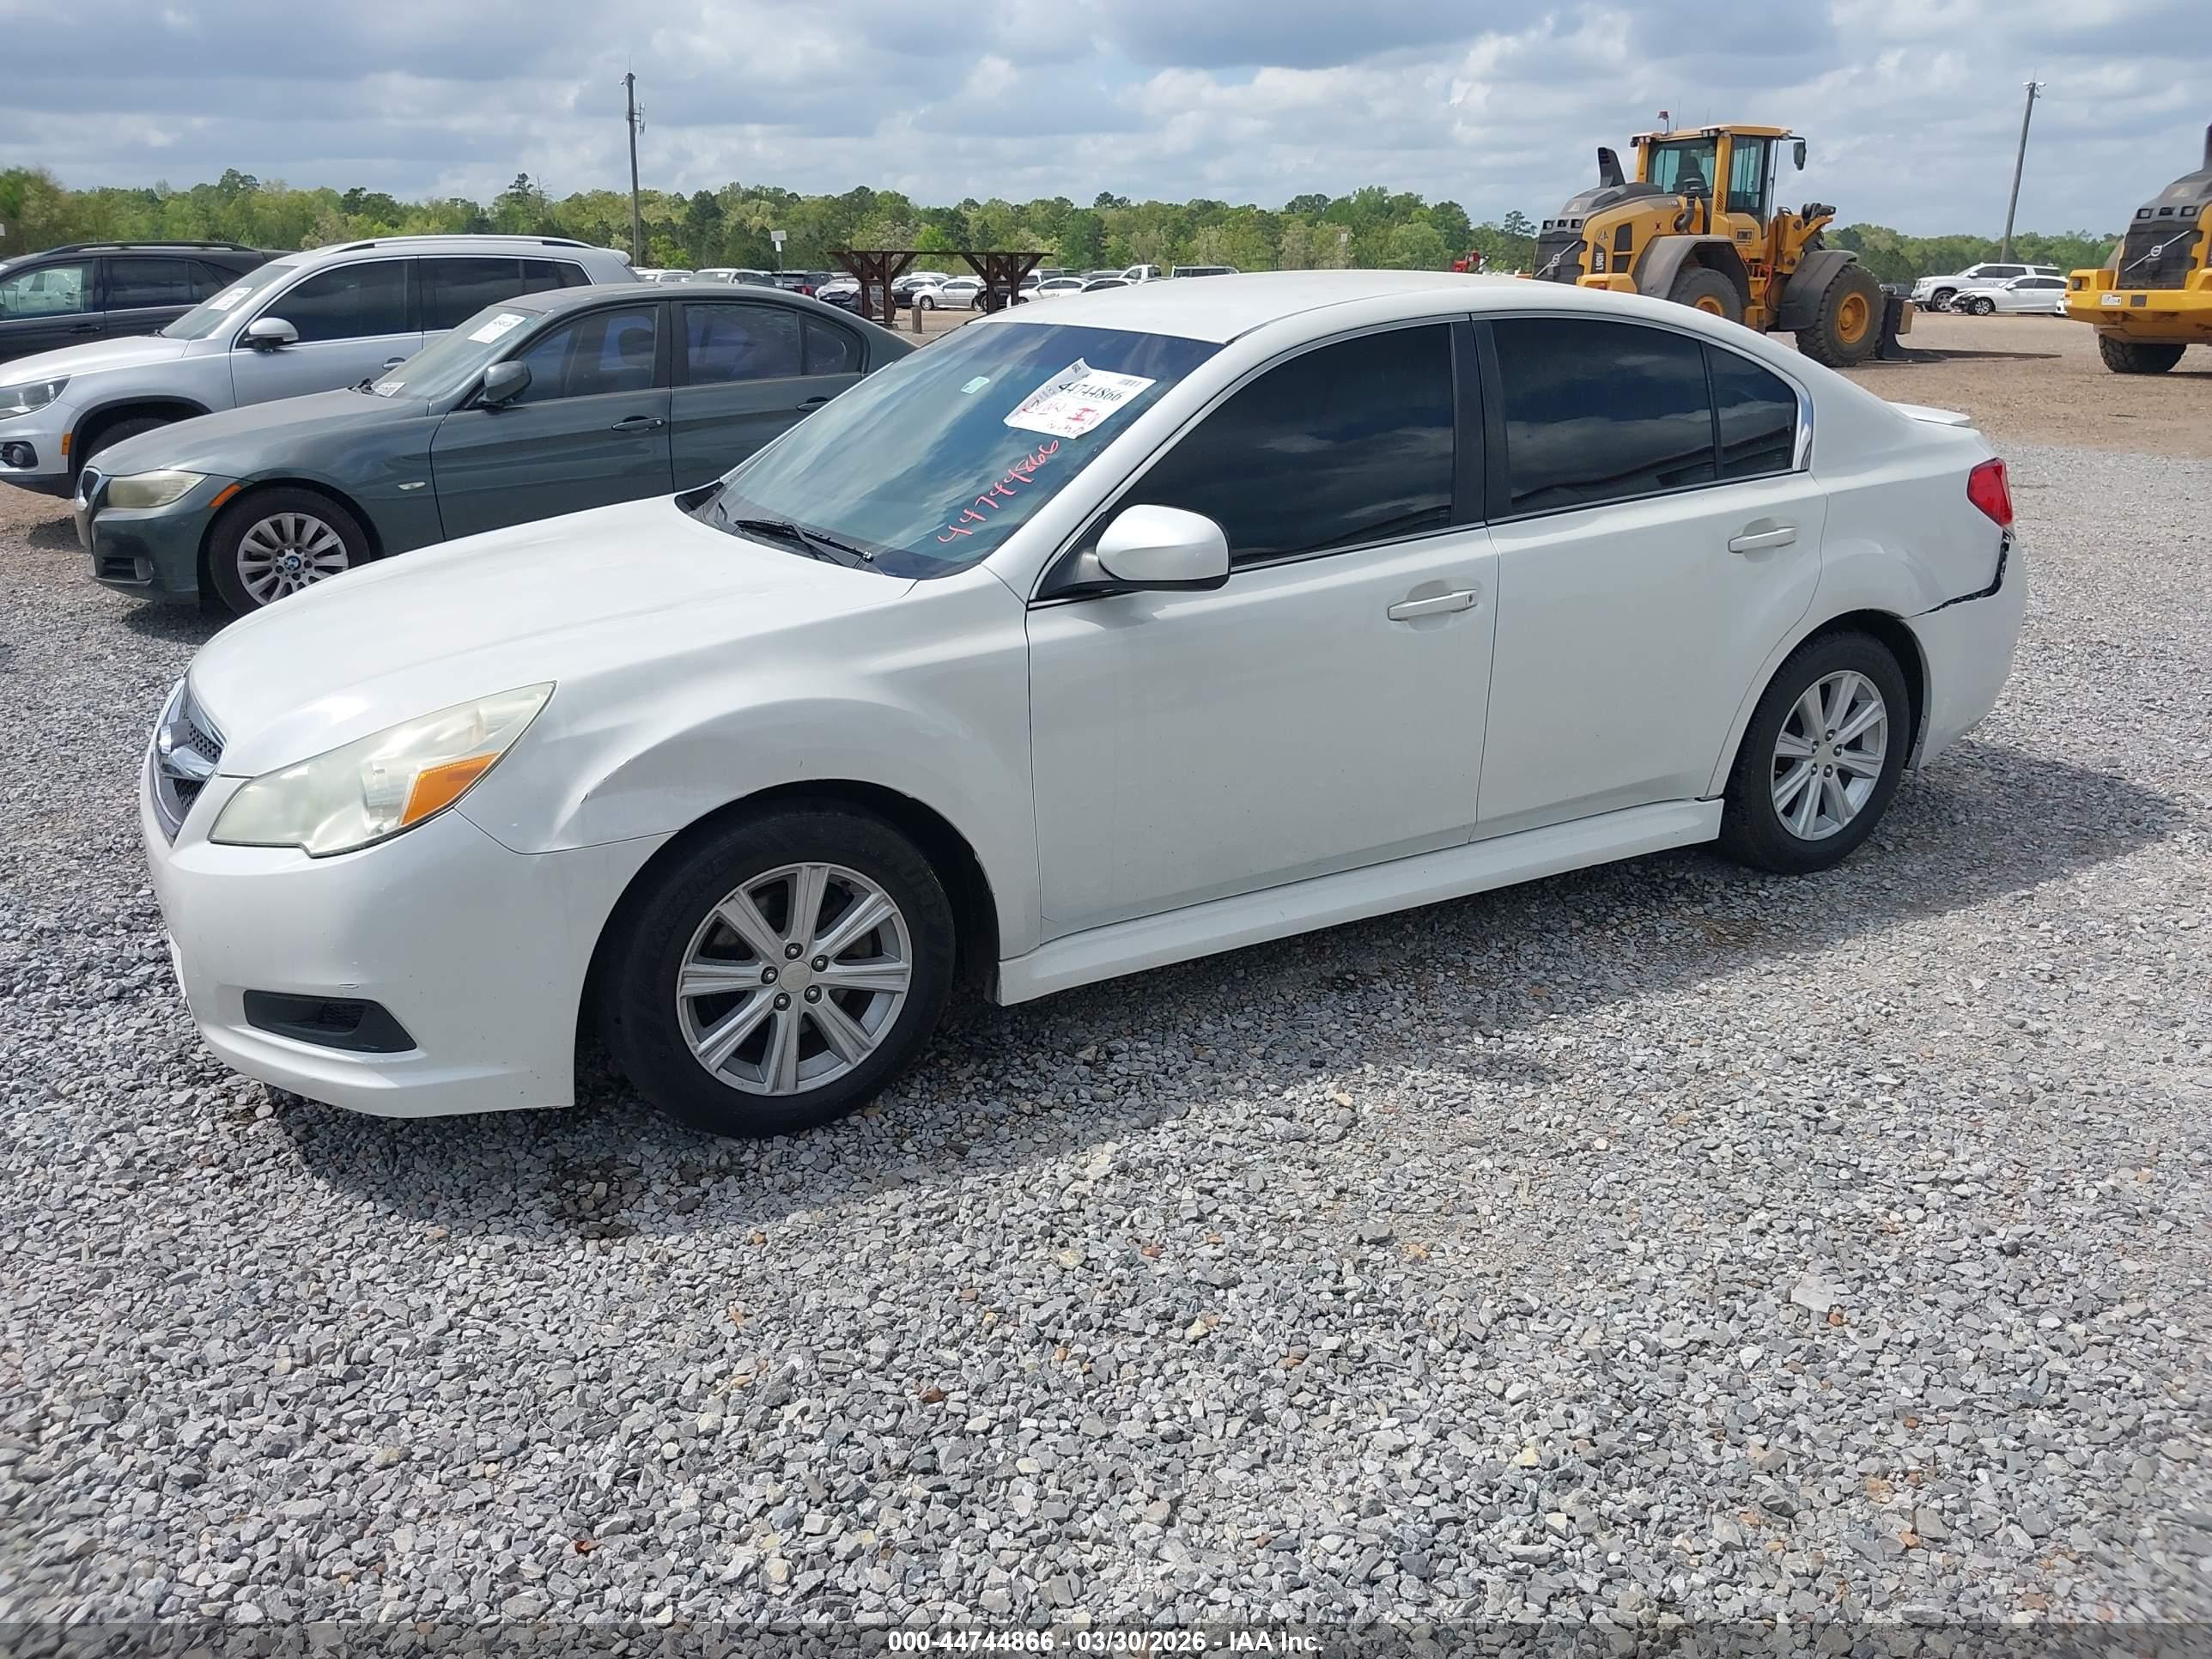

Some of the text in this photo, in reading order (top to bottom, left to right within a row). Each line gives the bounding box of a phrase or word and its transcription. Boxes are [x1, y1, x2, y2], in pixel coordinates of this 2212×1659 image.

[1595, 252, 1605, 270] L90H
[1058, 381, 1127, 402] 44744866
[937, 439, 1059, 543] 44744866
